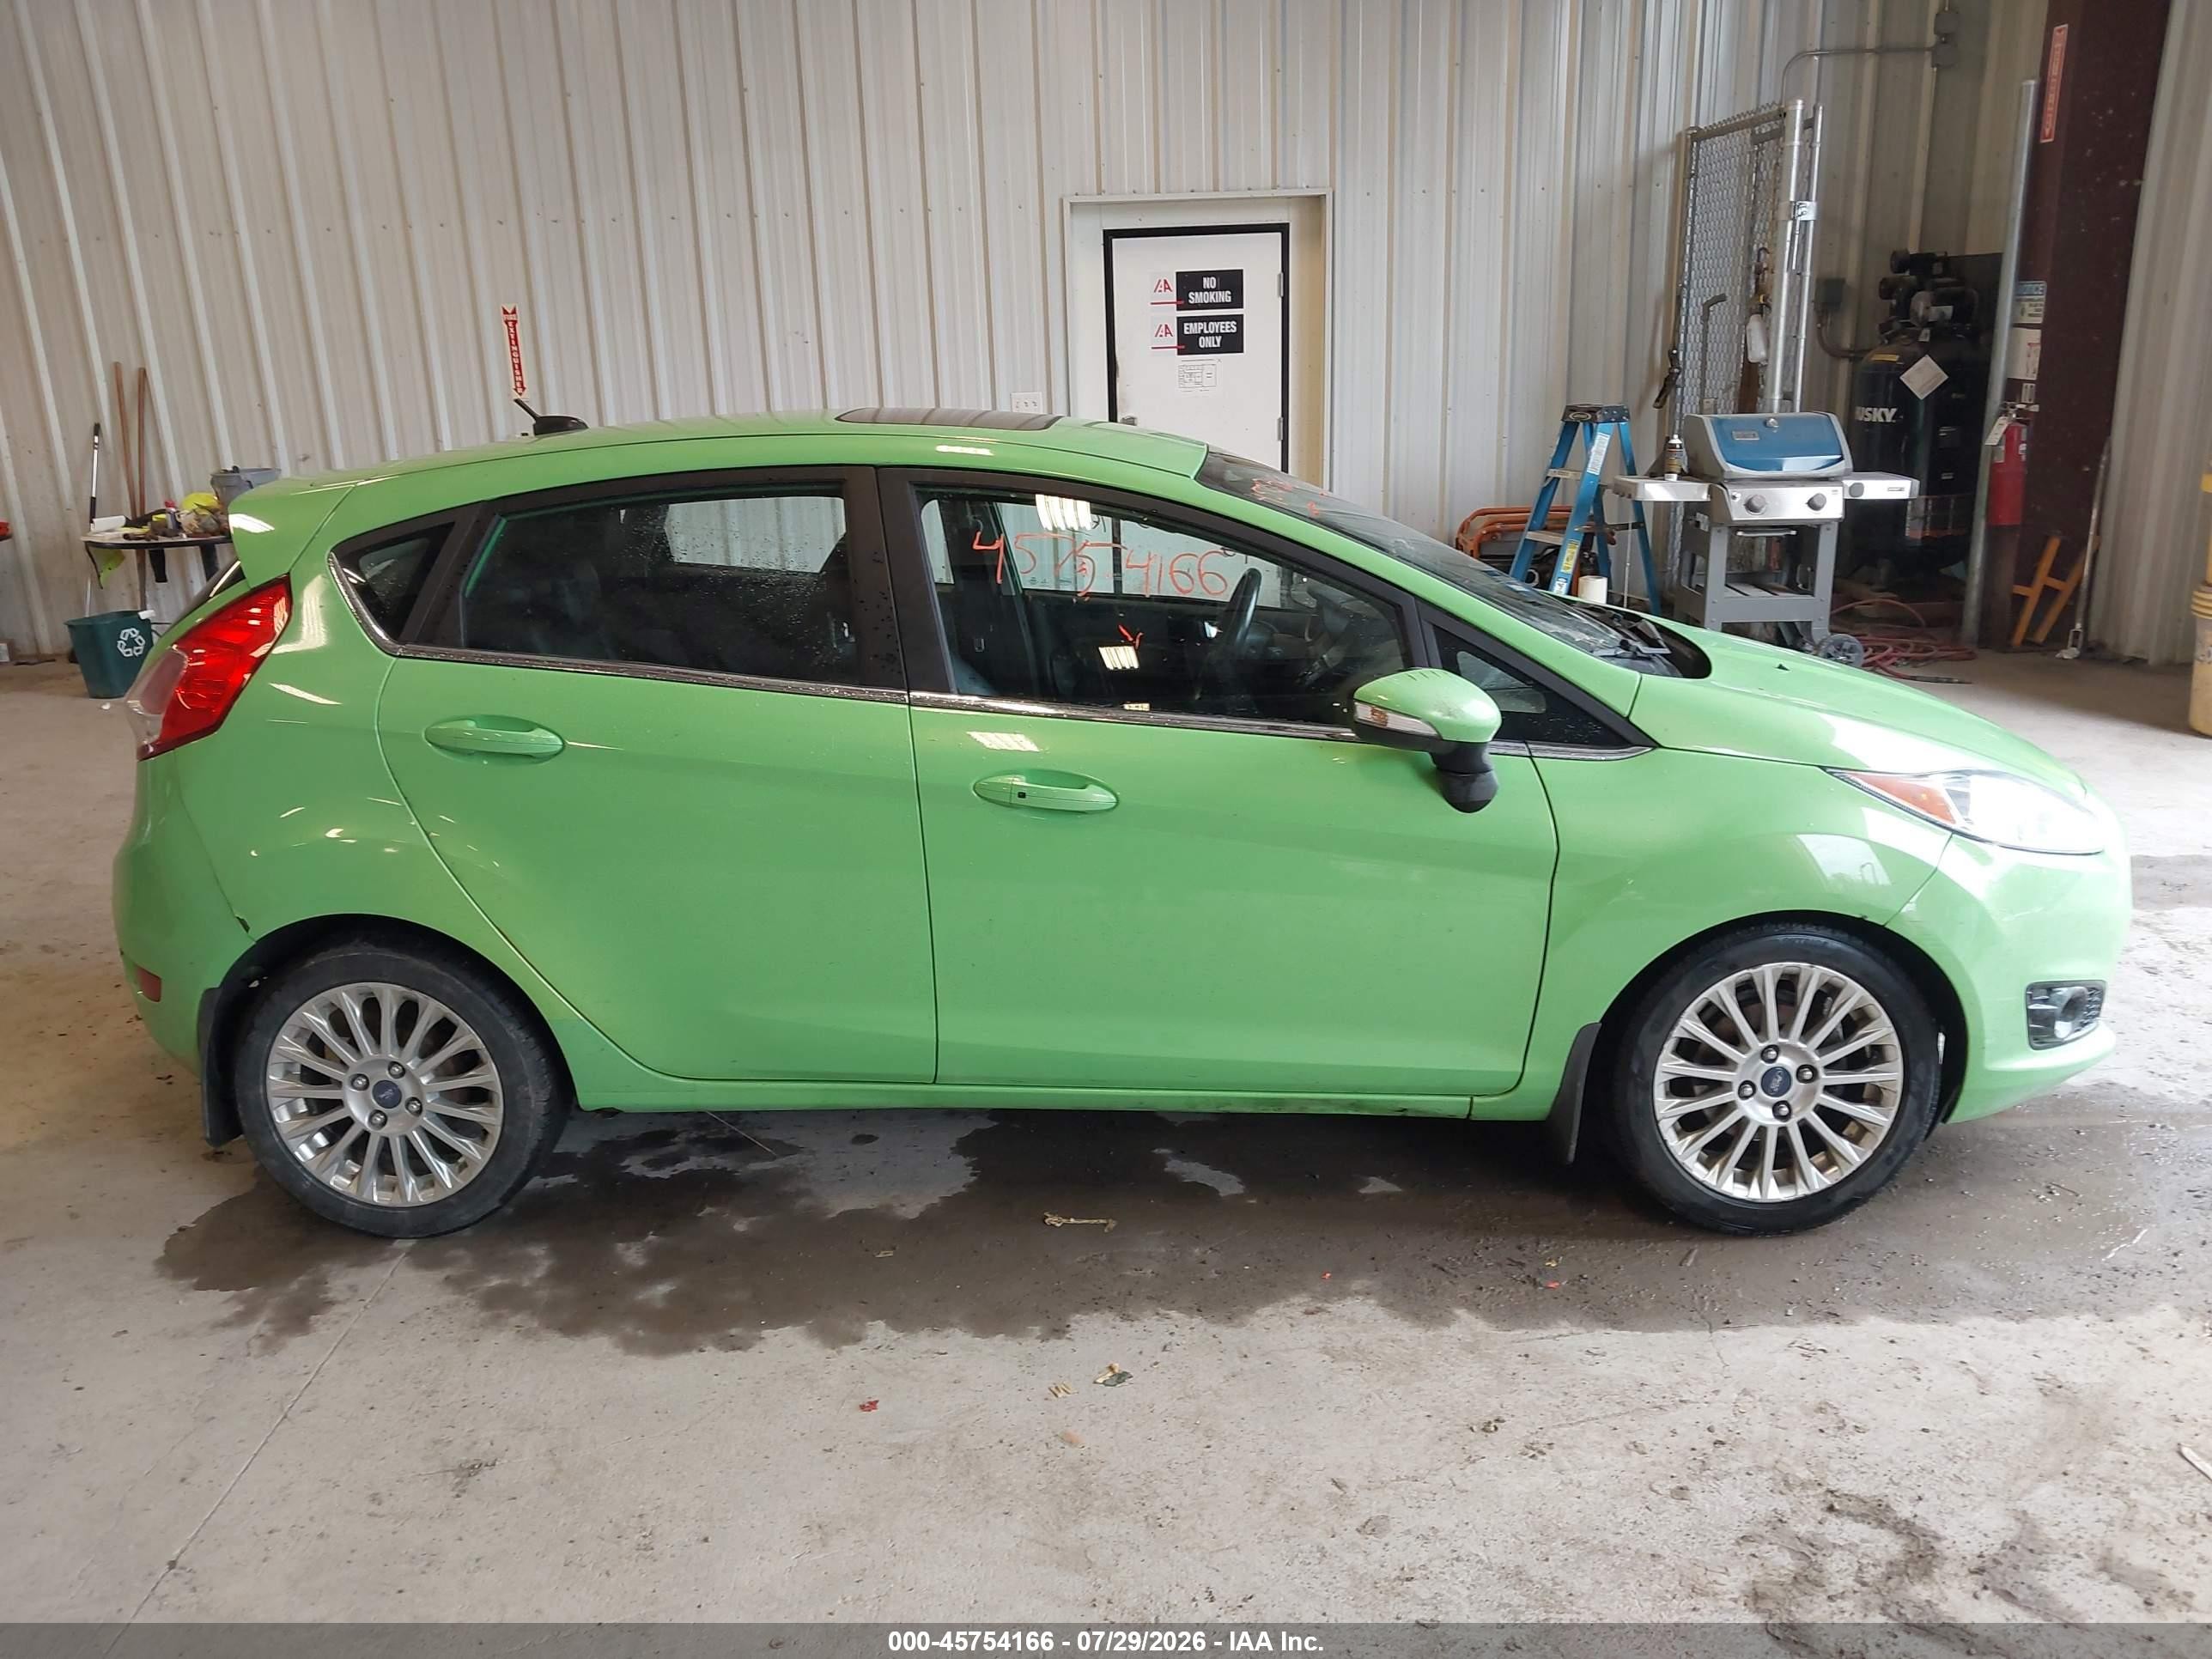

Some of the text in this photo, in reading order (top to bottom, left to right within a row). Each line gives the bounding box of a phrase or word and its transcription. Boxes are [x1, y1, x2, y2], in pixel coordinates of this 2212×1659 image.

[1202, 276, 1217, 289] NO
[1188, 290, 1231, 304] SMOKING
[1183, 321, 1237, 334] EMPLOYEES
[1198, 336, 1222, 349] ONLY
